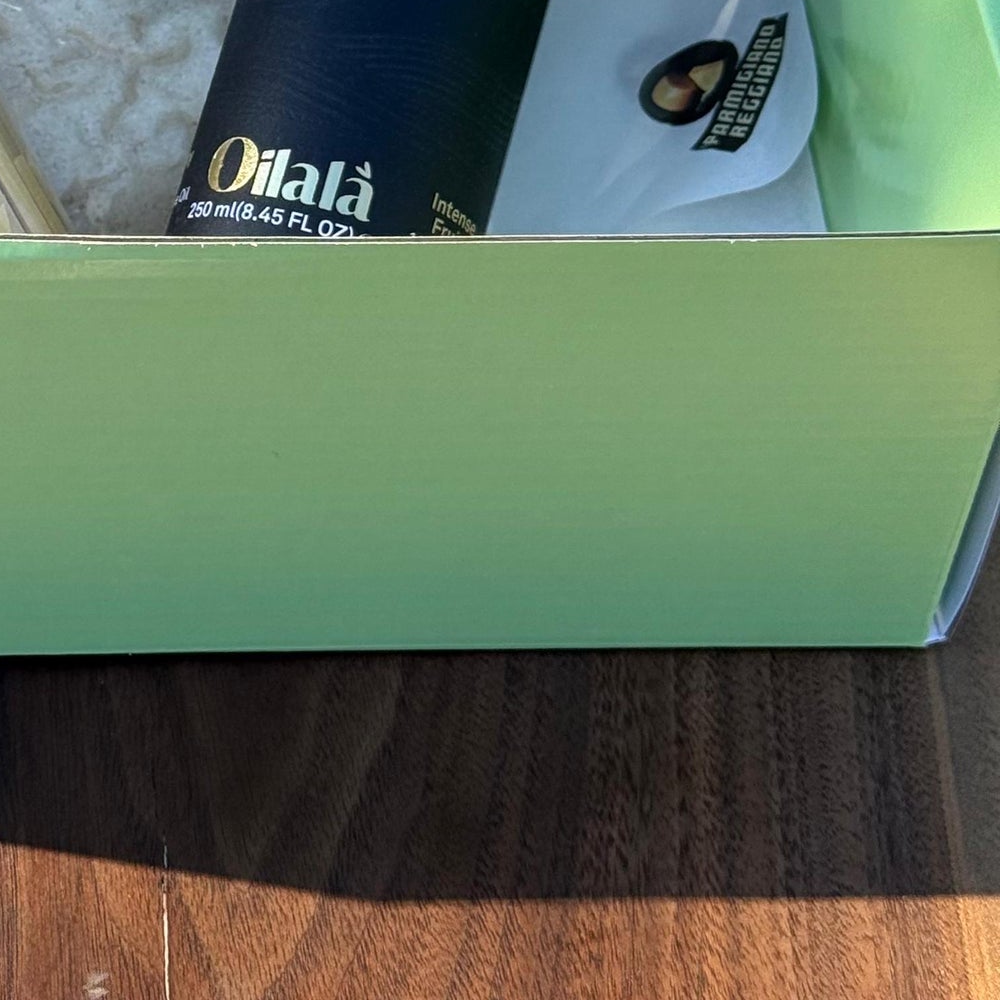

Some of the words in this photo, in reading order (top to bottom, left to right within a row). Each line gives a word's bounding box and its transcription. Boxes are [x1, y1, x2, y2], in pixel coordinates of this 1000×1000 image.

[703, 23, 777, 148] PARMIGIANO
[730, 37, 784, 140] REGGIANO
[187, 201, 213, 219] 250
[287, 211, 313, 235] FL
[317, 219, 354, 237] OZ)
[206, 136, 374, 222] Oilalà
[432, 192, 477, 236] Intense
